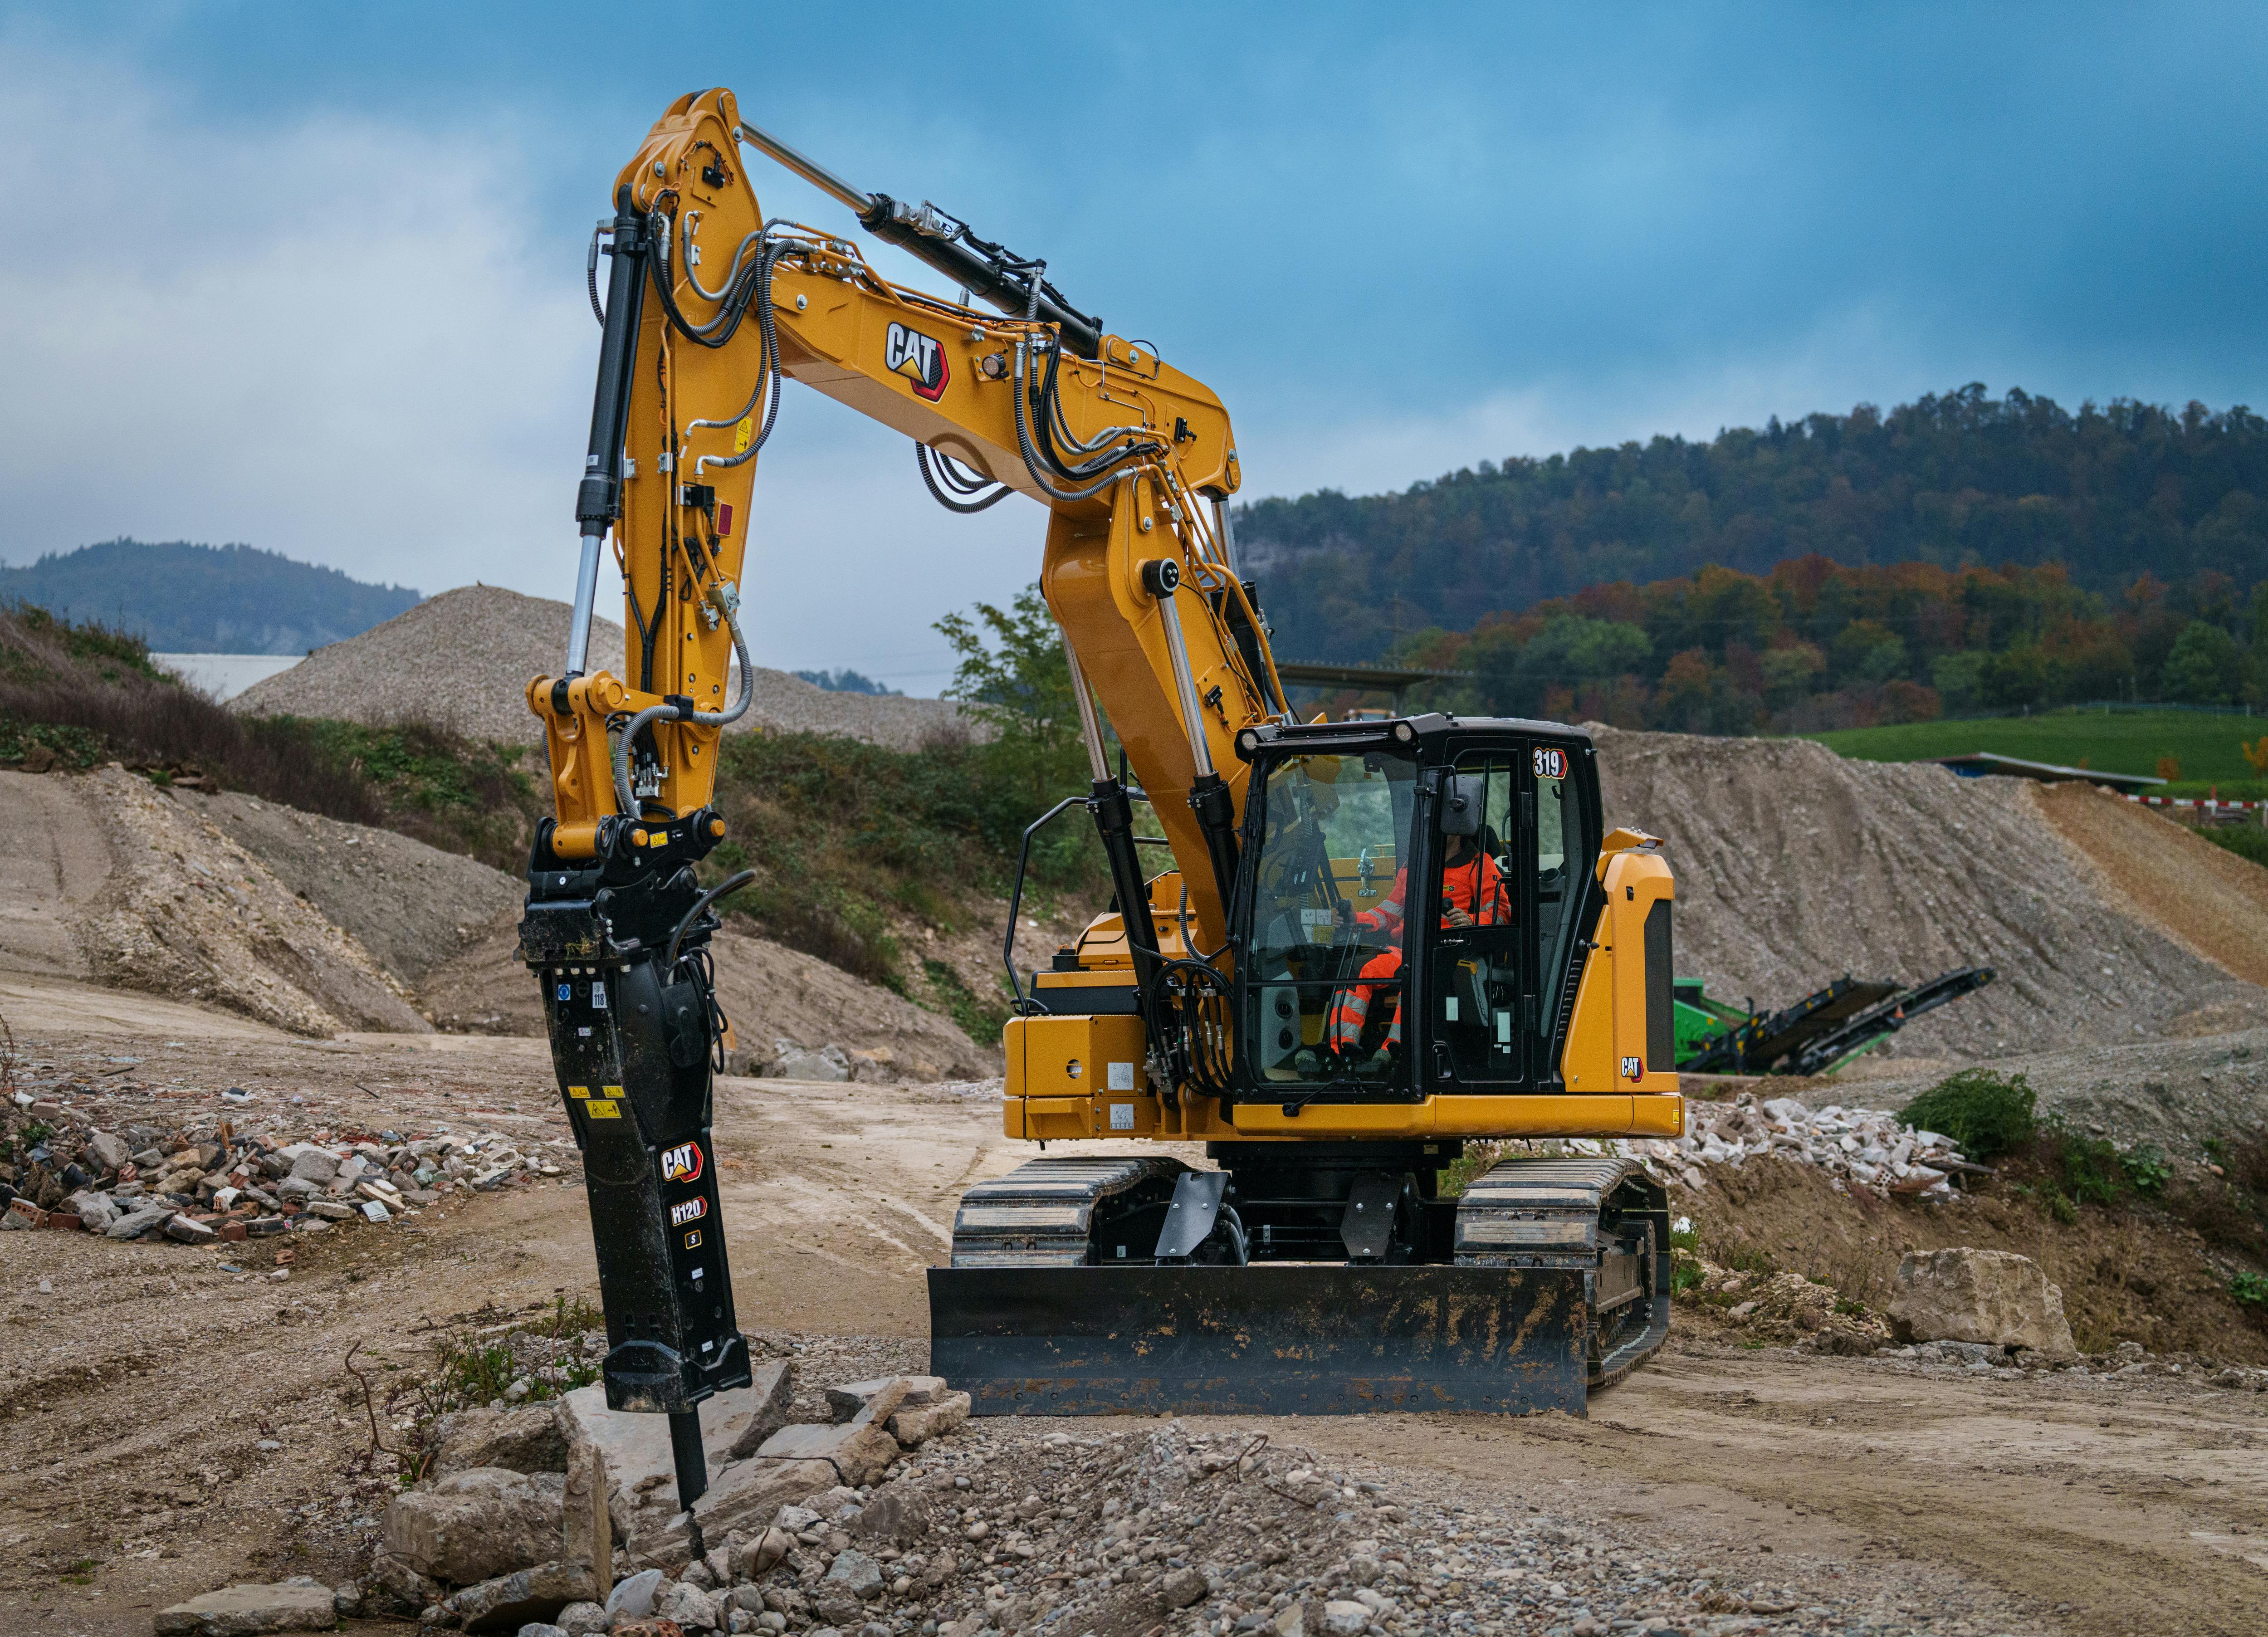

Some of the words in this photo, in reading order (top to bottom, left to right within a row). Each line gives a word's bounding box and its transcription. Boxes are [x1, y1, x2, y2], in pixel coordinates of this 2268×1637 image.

[887, 323, 936, 384] CAT
[1535, 749, 1559, 776] 319
[594, 994, 604, 1006] 118
[1622, 1057, 1638, 1077] CAT
[662, 1144, 691, 1179] CAT
[672, 1199, 700, 1224] H120
[691, 1235, 695, 1244] S
